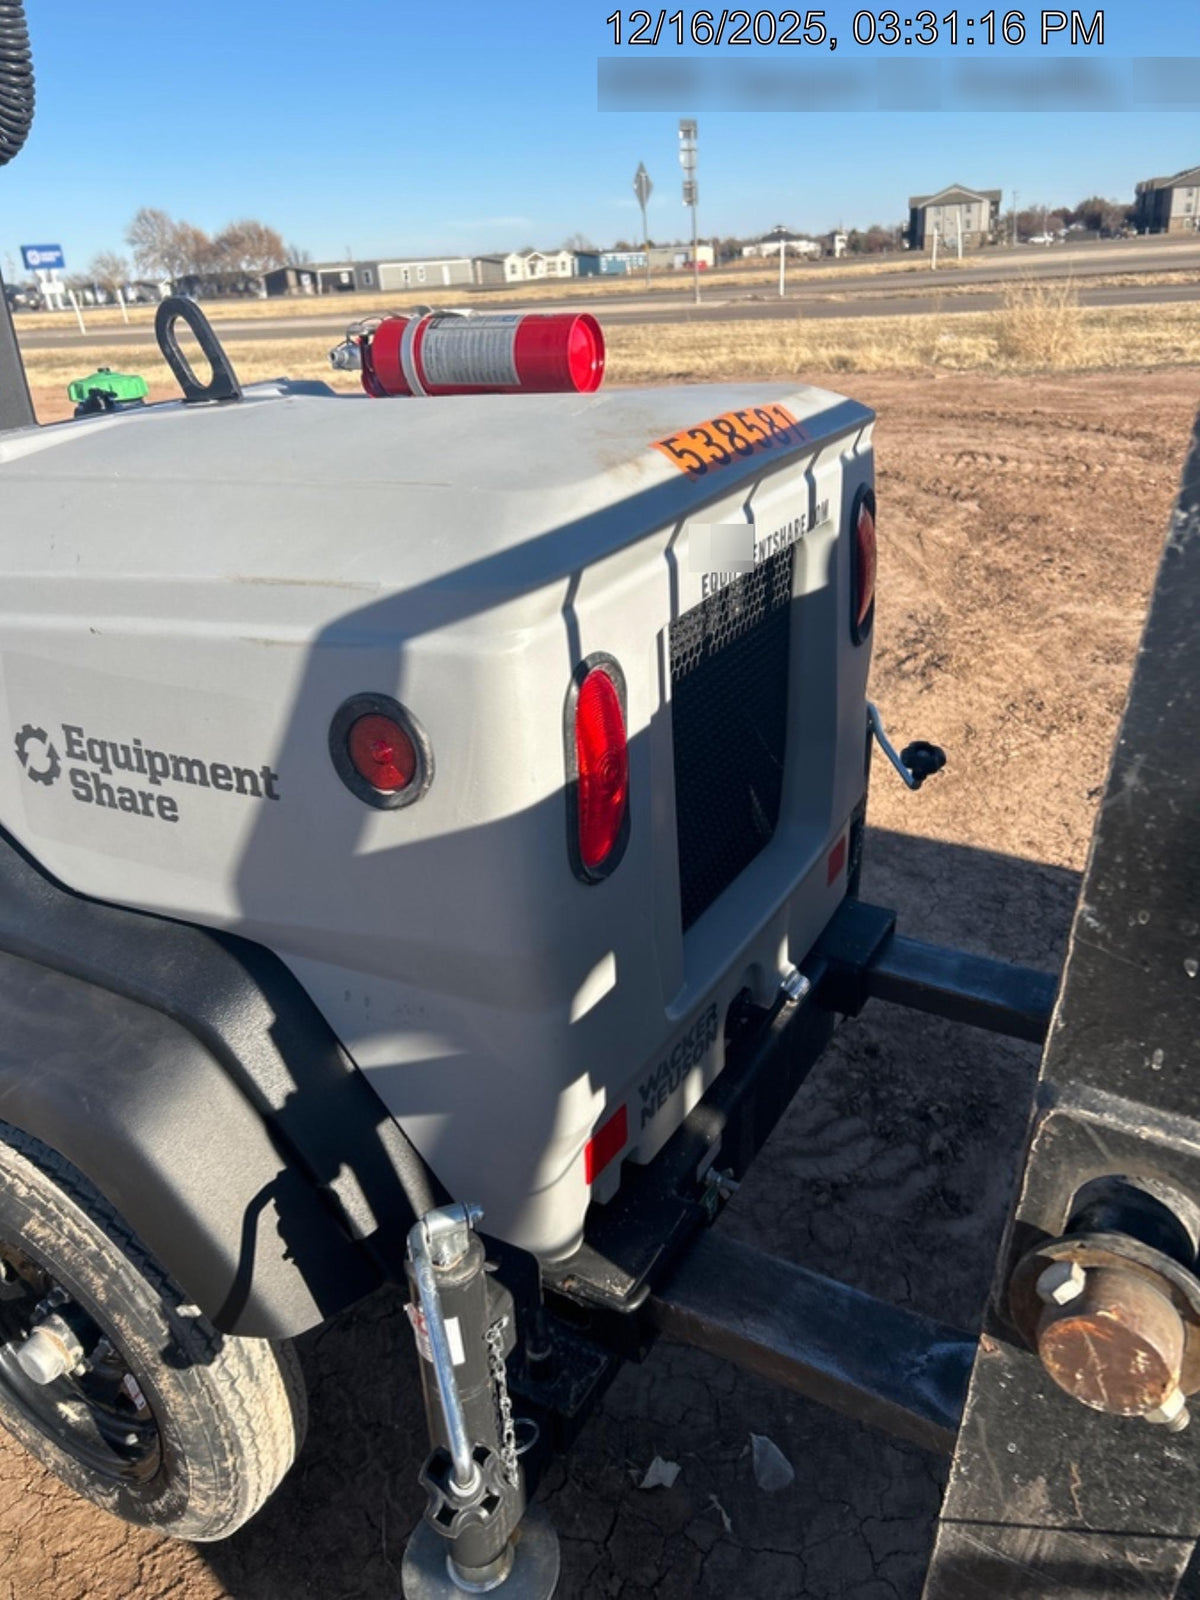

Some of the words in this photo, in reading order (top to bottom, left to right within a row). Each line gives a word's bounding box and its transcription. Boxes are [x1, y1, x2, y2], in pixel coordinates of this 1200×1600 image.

[659, 406, 806, 476] 538581
[61, 723, 281, 801] Equipment
[69, 767, 180, 823] Share
[639, 1002, 718, 1102] WACKER
[640, 1021, 719, 1130] NEUSON
